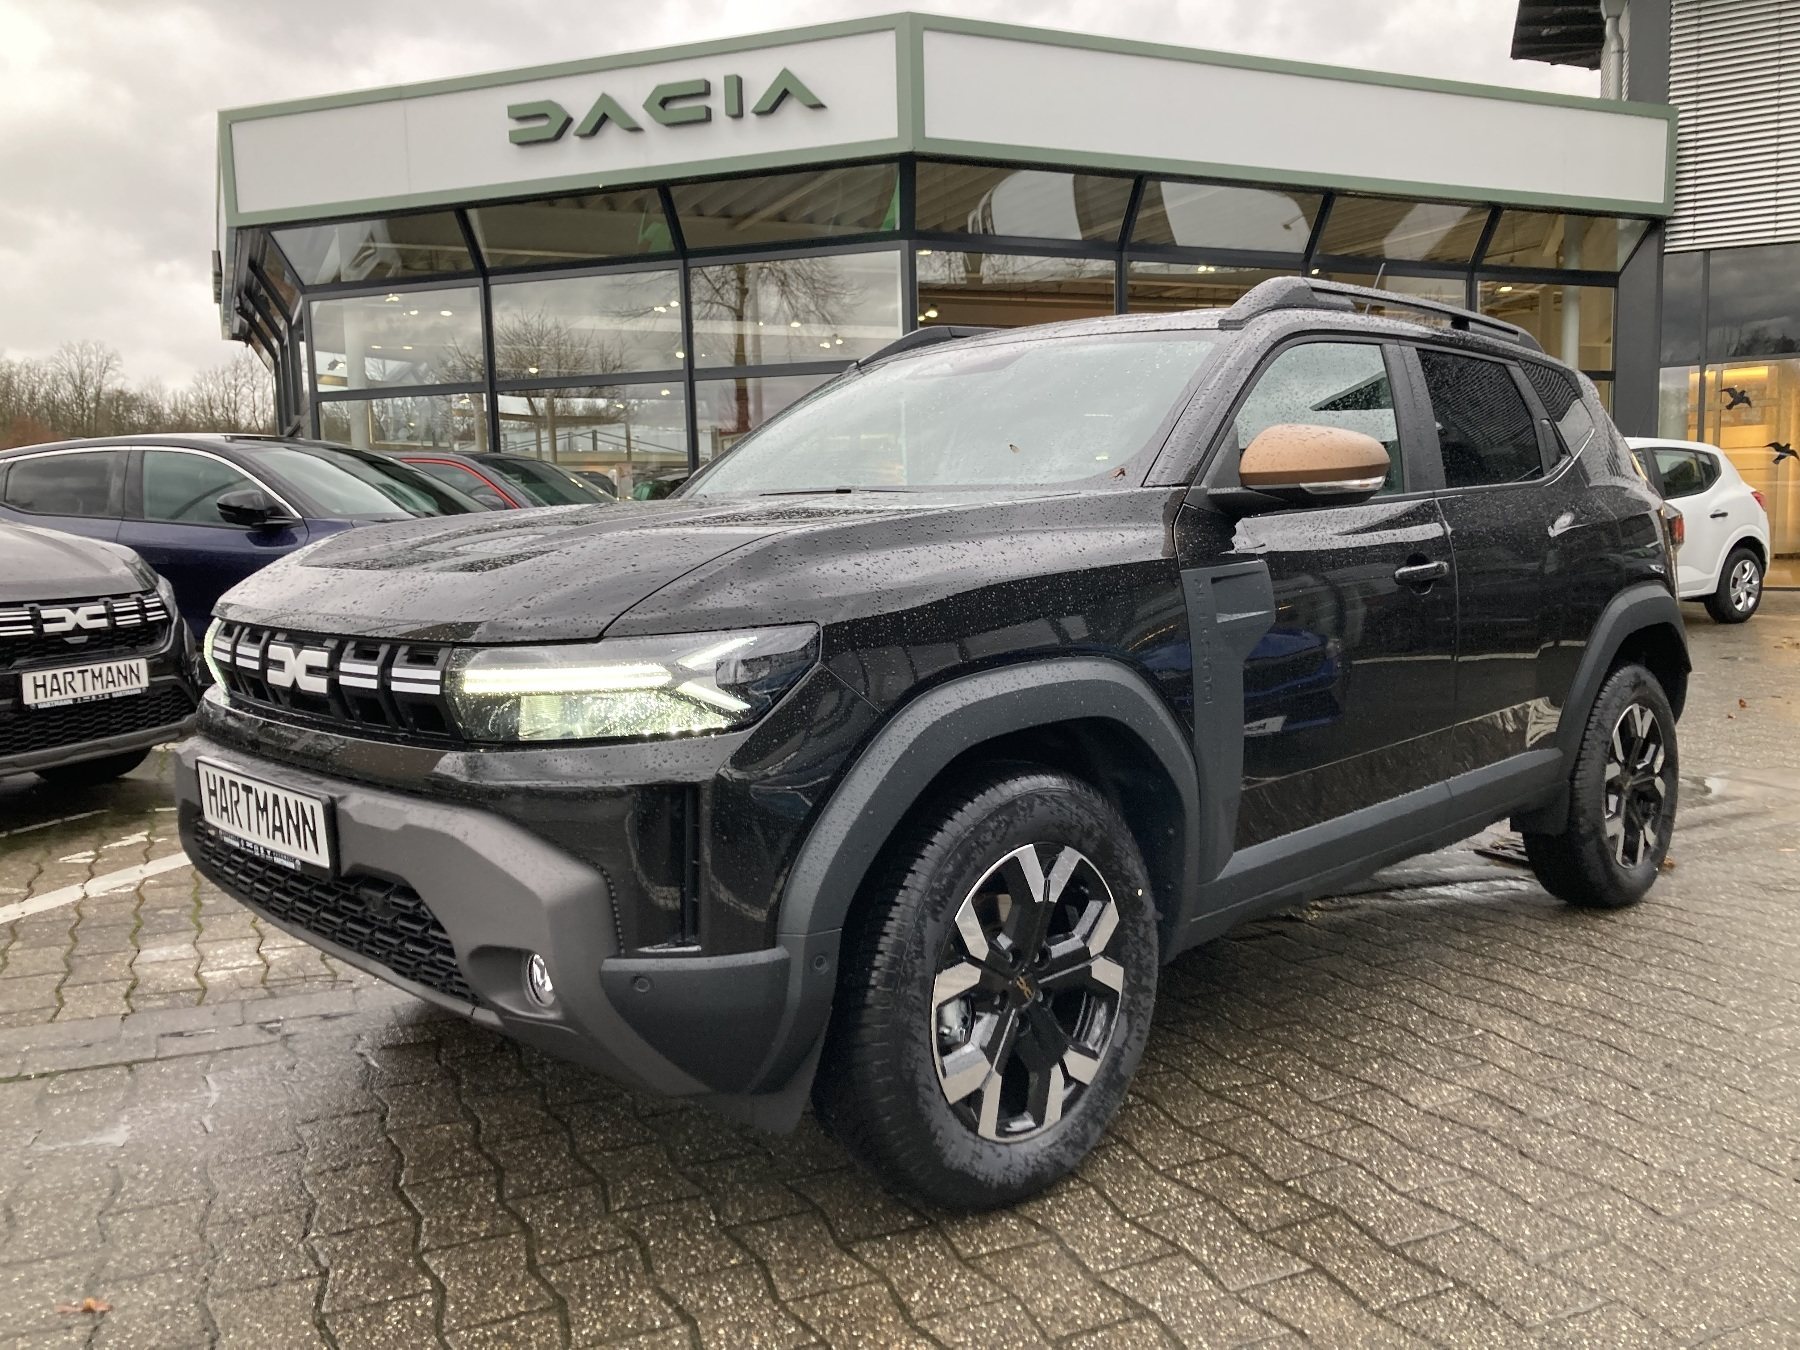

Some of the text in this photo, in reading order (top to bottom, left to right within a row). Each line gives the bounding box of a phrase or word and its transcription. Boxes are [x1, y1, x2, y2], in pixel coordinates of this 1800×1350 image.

[507, 67, 827, 145] DACIA
[32, 662, 141, 700] HARTMANN
[205, 770, 319, 855] HARTMANN
